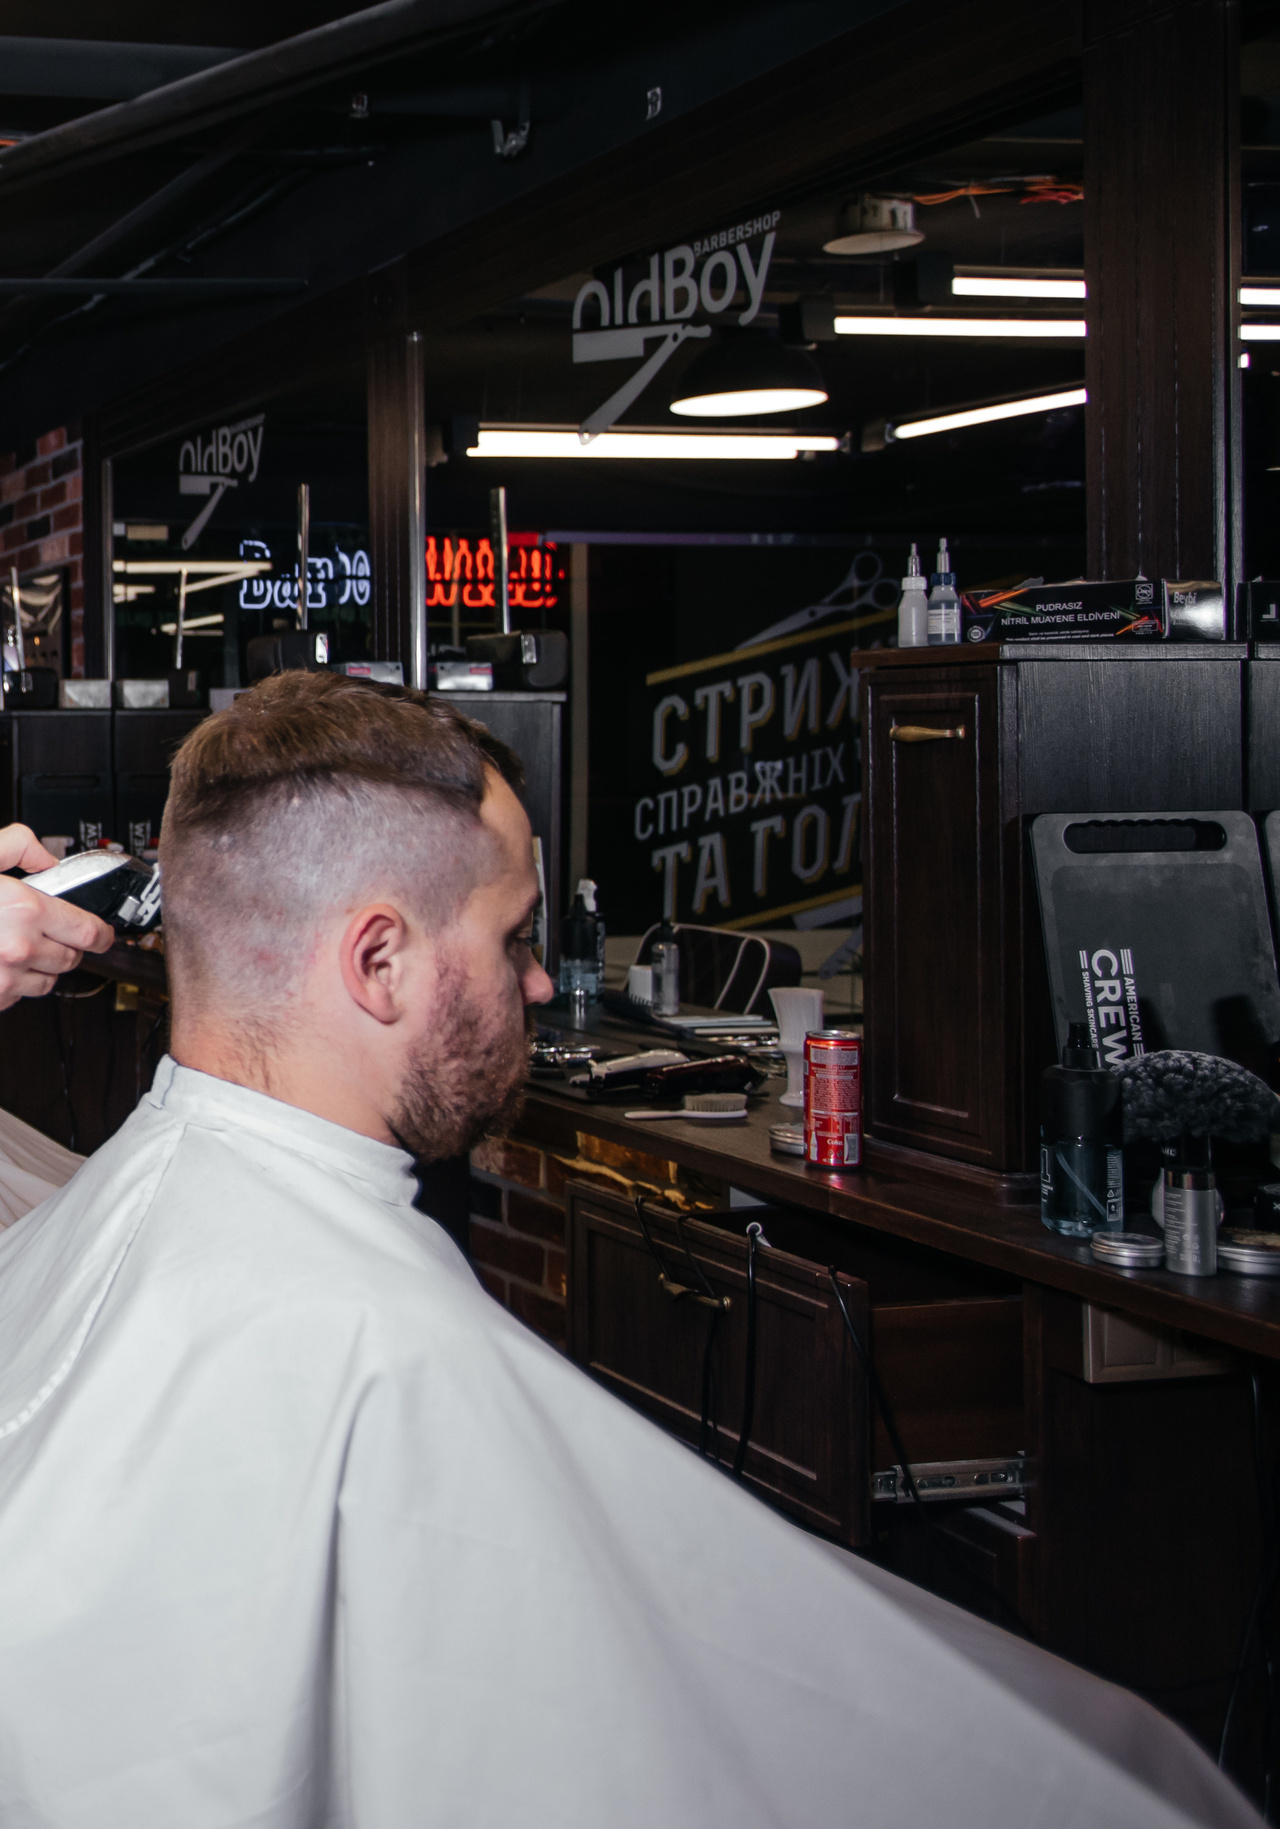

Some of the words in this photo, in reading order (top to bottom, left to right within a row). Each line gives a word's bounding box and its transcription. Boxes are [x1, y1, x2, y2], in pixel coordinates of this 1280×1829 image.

[693, 210, 781, 257] BARBERSHOP
[1030, 614, 1075, 625] MUAYENE
[1035, 602, 1083, 612] PUDRASIZ
[634, 742, 846, 841] СПРАВЖНІХ
[651, 826, 731, 922] ТА
[1082, 971, 1093, 1007] SHAVING
[1091, 949, 1129, 1067] CREW
[1124, 977, 1143, 1041] AMERICAN
[1087, 1008, 1099, 1049] SKINCARE
